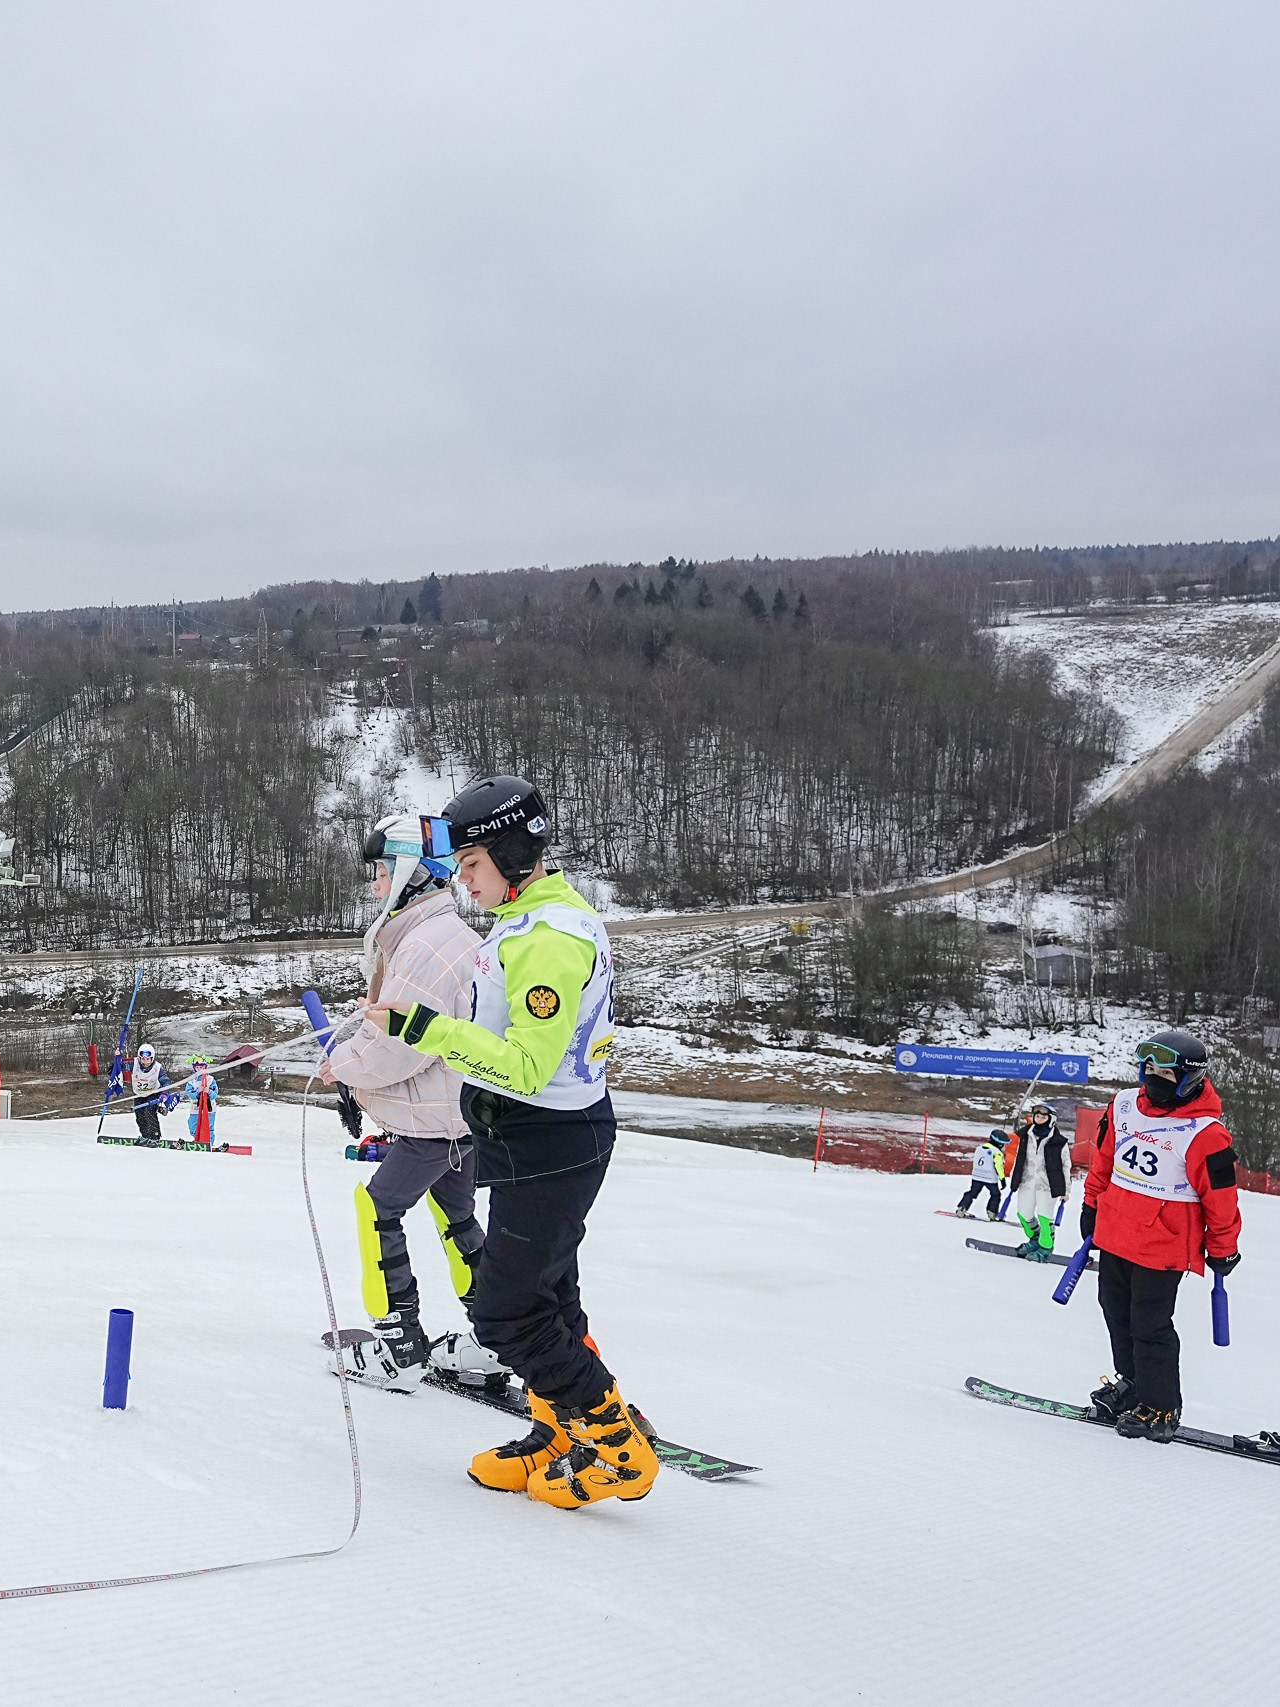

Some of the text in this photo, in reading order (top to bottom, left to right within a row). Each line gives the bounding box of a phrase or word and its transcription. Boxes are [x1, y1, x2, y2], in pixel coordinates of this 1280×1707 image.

[467, 808, 525, 838] SMITH
[447, 1050, 510, 1081] Shukolovo
[921, 1051, 953, 1061] Реклама
[468, 1069, 539, 1097] Snowboard
[977, 1156, 985, 1167] 6
[1121, 1144, 1159, 1177] 43
